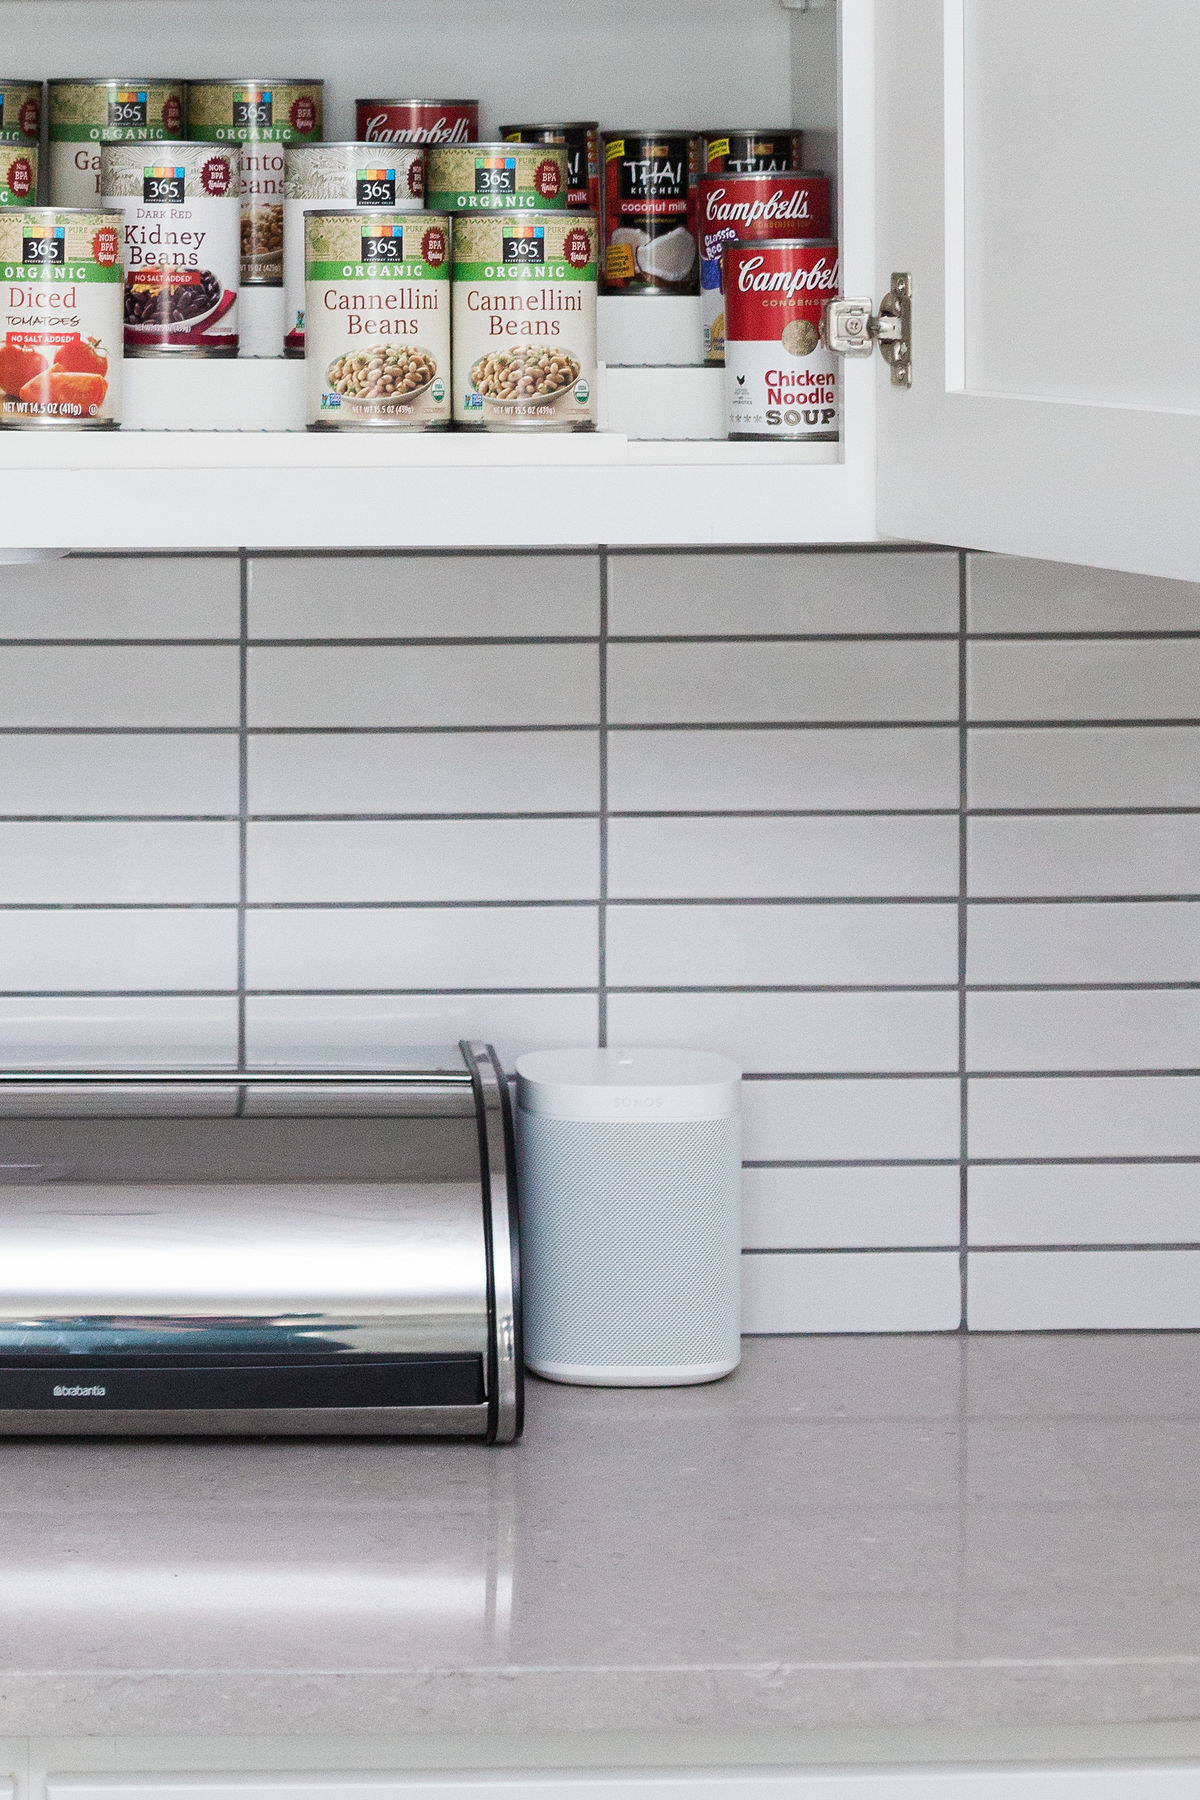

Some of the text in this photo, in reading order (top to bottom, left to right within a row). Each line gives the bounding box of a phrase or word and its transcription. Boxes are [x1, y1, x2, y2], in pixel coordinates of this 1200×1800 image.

[114, 103, 142, 122] 365
[238, 104, 267, 122] 365
[89, 128, 164, 140] ORGANIC
[215, 128, 292, 140] ORGANIC
[208, 164, 226, 172] NON-
[240, 153, 284, 172] into
[210, 172, 224, 180] BPA
[480, 169, 511, 188] 365
[542, 172, 557, 182] BPA
[622, 160, 683, 185] THAI
[149, 178, 180, 198] 365
[362, 181, 392, 200] 365
[630, 186, 680, 194] KITCHEN
[457, 195, 536, 208] ORGANIC
[567, 191, 587, 202] milk
[136, 208, 192, 219] DARK RED
[621, 201, 687, 212] coconut milk
[706, 188, 810, 227] Campbell's
[97, 233, 117, 242] NON-
[124, 223, 207, 250] Kidney
[27, 241, 59, 259] 365
[100, 242, 115, 251] BPA
[366, 237, 398, 257] 365
[428, 240, 442, 250] BPA
[508, 238, 539, 258] 365
[571, 240, 586, 251] BPA
[129, 245, 199, 266] Beans
[3, 266, 87, 280] ORGANIC
[134, 274, 163, 282] NO SALT
[342, 265, 423, 277] ORGANIC
[484, 266, 566, 278] ORGANIC
[8, 286, 78, 309] Diced
[323, 288, 439, 311] Cannellini
[467, 289, 582, 312] Cannellini
[5, 315, 81, 327] TOMATOES
[347, 314, 419, 336] Beans
[488, 315, 561, 336] Beans
[11, 335, 43, 343] NO SALT
[764, 369, 836, 387] Chicken
[767, 387, 835, 406] Noodle
[2, 403, 16, 414] NET
[16, 403, 29, 414] WT
[29, 403, 47, 414] 14.5
[47, 403, 59, 414] OZ
[765, 408, 837, 427] SOUP
[63, 1384, 107, 1397] brabantia
